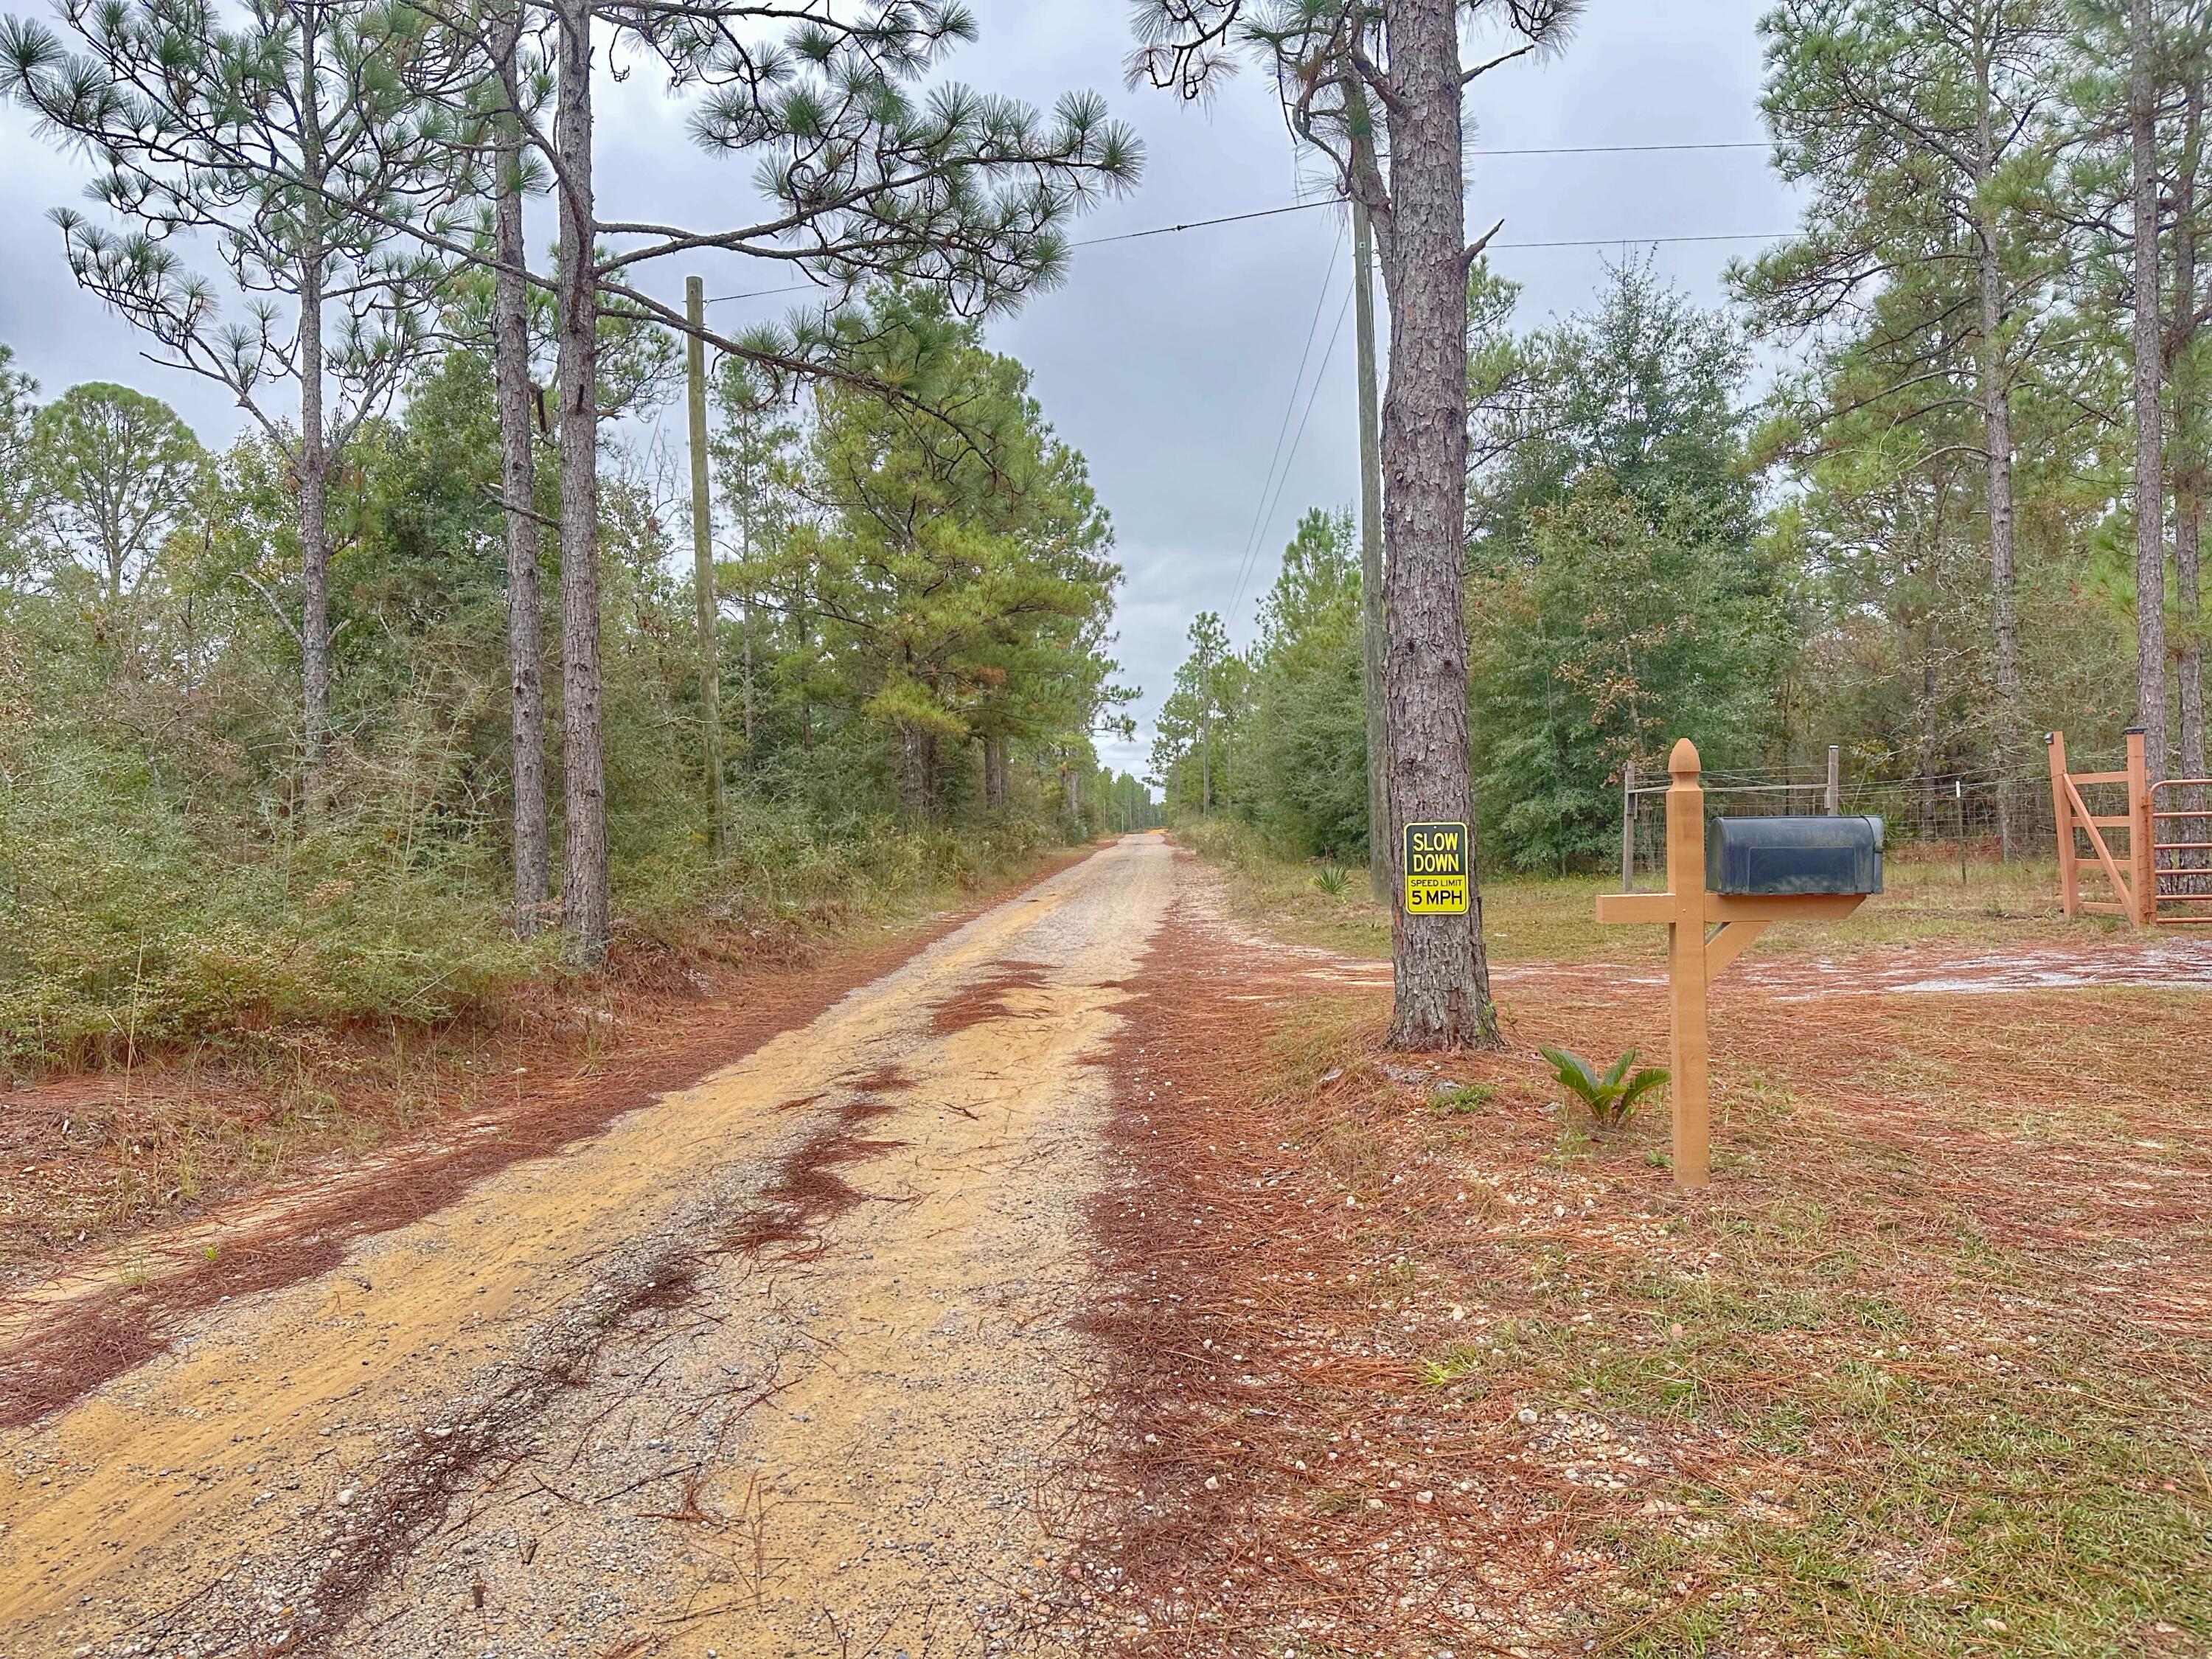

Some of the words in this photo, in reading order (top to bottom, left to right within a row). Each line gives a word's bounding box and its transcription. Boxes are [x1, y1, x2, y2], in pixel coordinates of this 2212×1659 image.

[1413, 832, 1458, 851] SLOW
[1413, 854, 1458, 872] DOWN
[1412, 891, 1422, 905] 5
[1427, 890, 1462, 905] MPH
